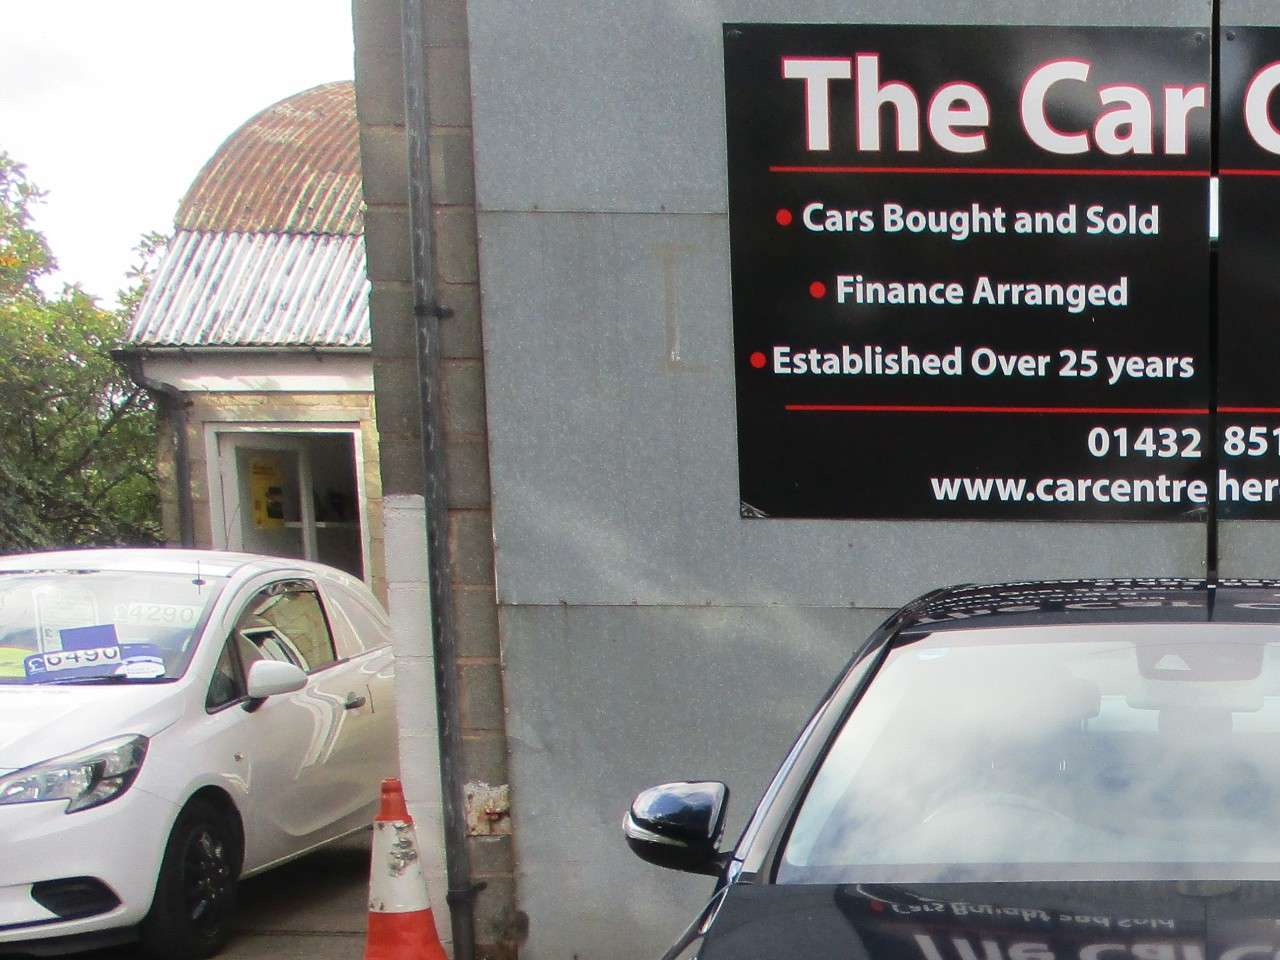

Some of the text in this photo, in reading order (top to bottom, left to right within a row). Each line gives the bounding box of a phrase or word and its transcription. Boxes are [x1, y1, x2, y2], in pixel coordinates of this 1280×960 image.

[782, 53, 990, 154] The
[1020, 58, 1205, 156] Car
[802, 203, 1159, 240] Cars Bought and Sold
[836, 275, 1128, 313] Finance Arranged
[773, 345, 1195, 385] Established Over 25 years
[1087, 426, 1202, 458] 01432
